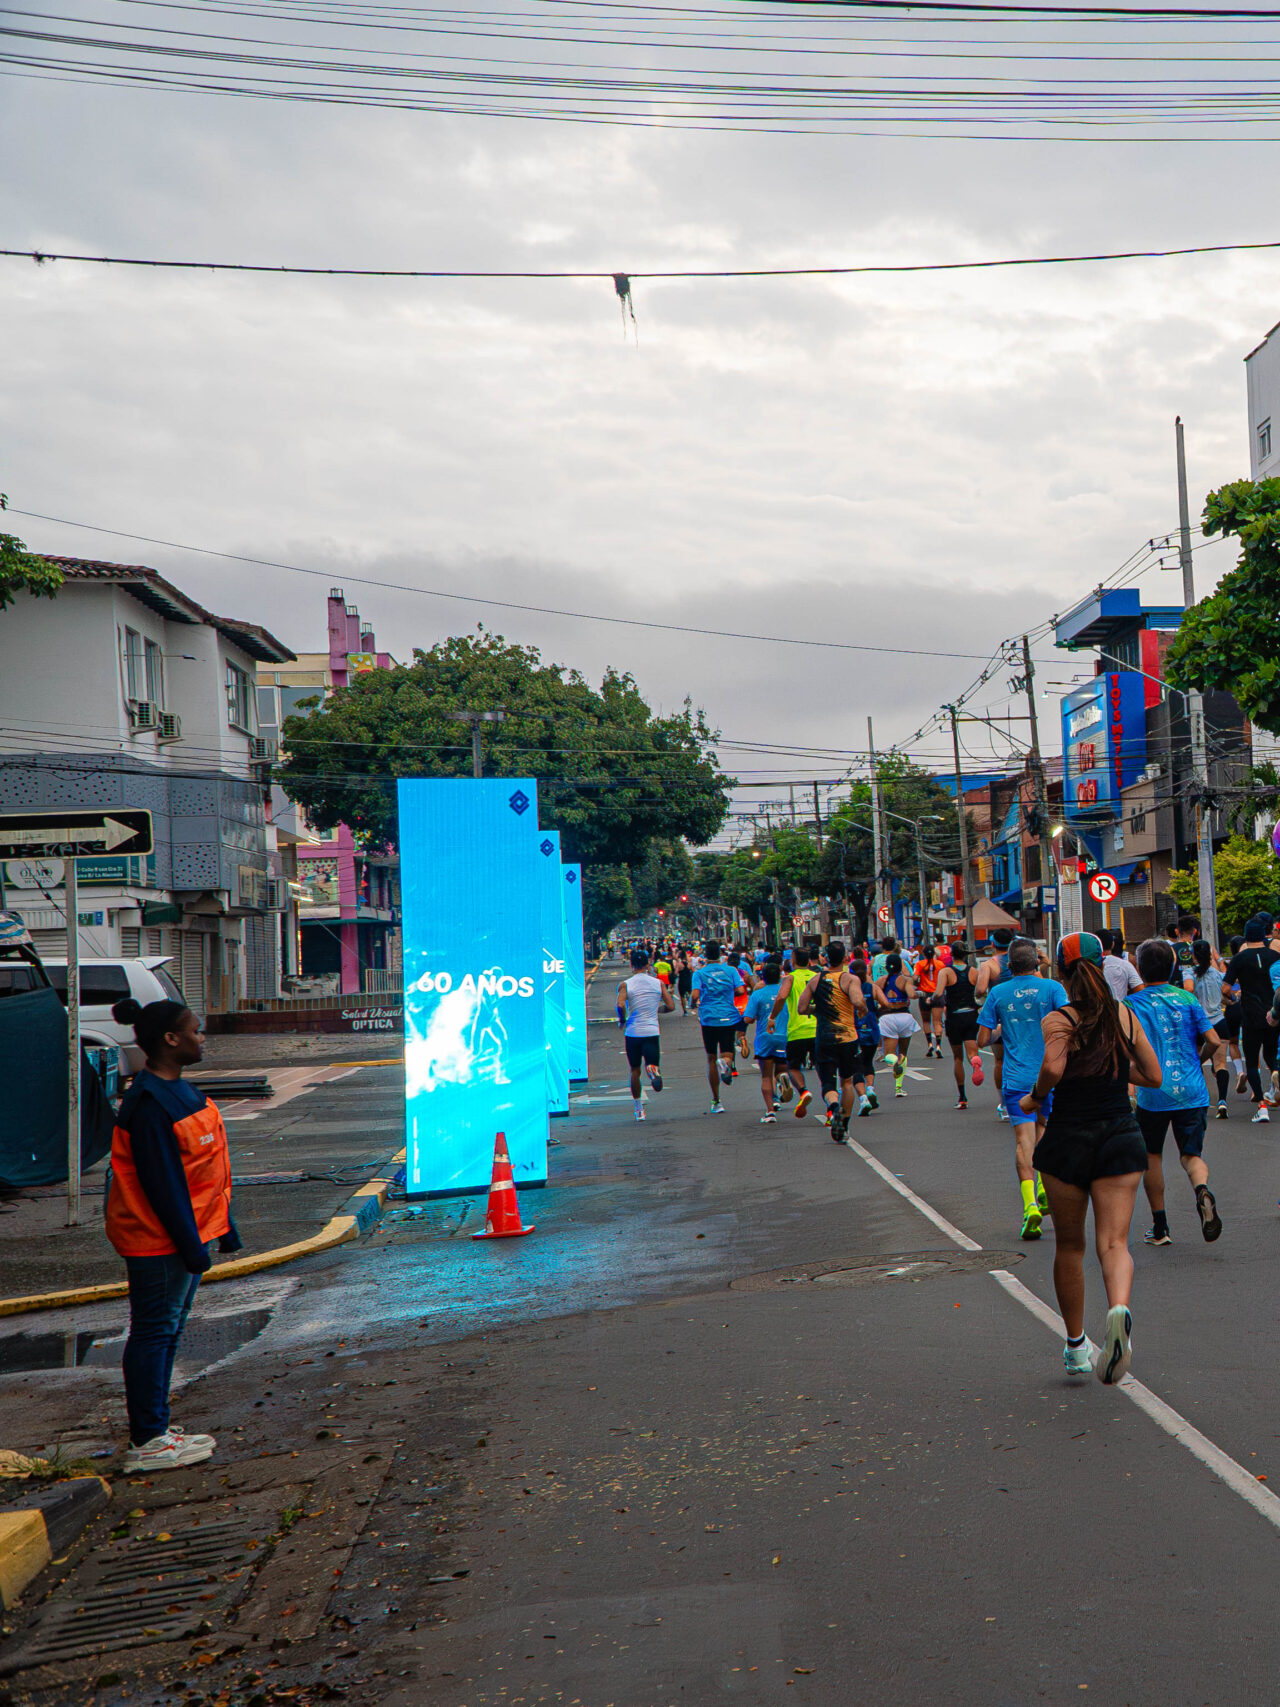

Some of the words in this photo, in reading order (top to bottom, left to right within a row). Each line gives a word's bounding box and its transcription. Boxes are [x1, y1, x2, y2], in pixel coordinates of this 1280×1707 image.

[1110, 674, 1121, 722] TOYS
[416, 971, 452, 994] 60
[457, 968, 535, 998] AÑOS
[341, 1008, 368, 1020] Salud
[369, 1007, 403, 1018] Visual
[352, 1018, 394, 1030] OPTICA
